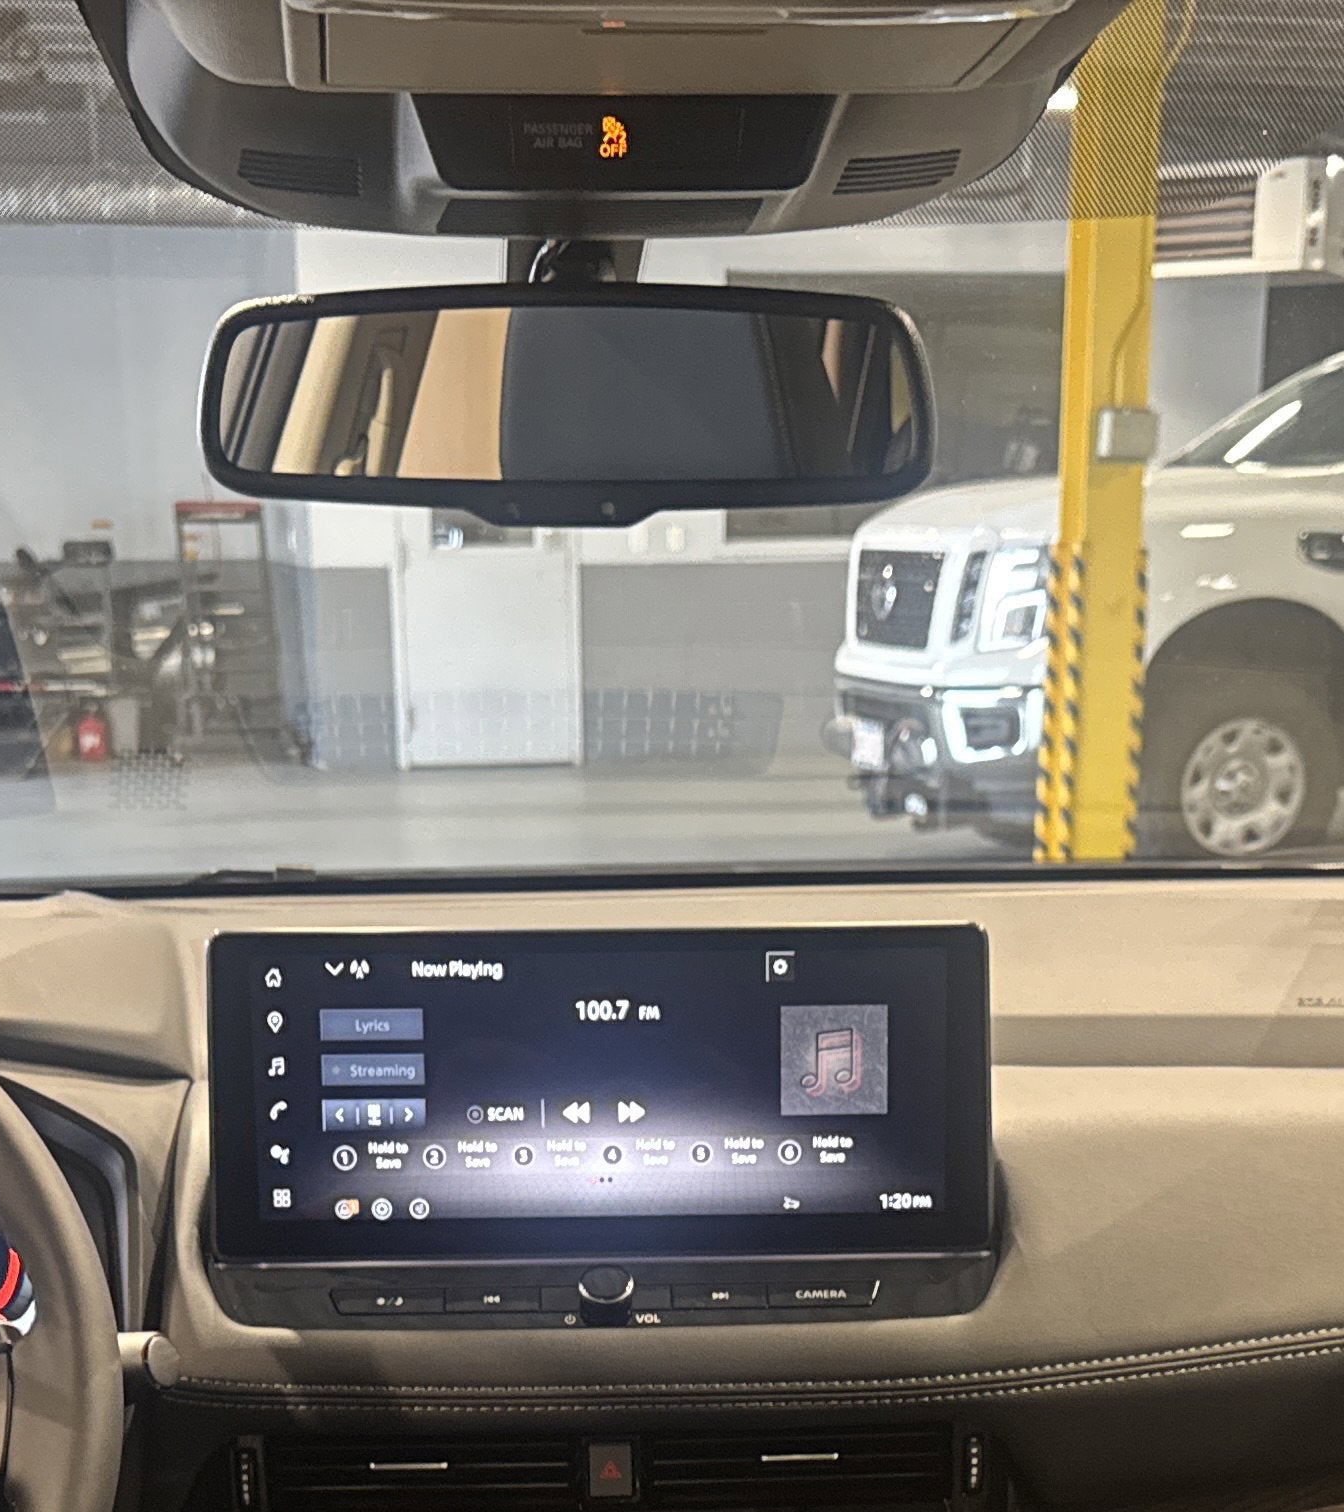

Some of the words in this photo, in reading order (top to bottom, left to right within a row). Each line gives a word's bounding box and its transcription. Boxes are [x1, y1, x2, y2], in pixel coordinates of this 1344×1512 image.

[523, 122, 593, 137] PASSENGER
[533, 137, 555, 149] AIR
[558, 137, 583, 149] BAG
[599, 143, 628, 158] OFF
[411, 960, 447, 978] Now
[448, 959, 504, 981] Playing
[575, 999, 630, 1022] 100.7
[638, 1004, 661, 1021] FM
[355, 1018, 391, 1035] Lyrics
[350, 1064, 416, 1081] Streaming
[487, 1106, 525, 1122] SCAN
[368, 1141, 393, 1155] Hold
[395, 1142, 409, 1155] to
[457, 1140, 482, 1154] Hold
[484, 1141, 498, 1154] to
[546, 1139, 571, 1152] Hold
[573, 1140, 587, 1152] to
[635, 1138, 660, 1151] Hold
[662, 1139, 676, 1151] to
[724, 1137, 749, 1150] Hold
[751, 1138, 765, 1150] to
[812, 1136, 837, 1149] Hold
[839, 1137, 854, 1149] to
[375, 1157, 403, 1170] Save
[465, 1156, 491, 1169] Save
[554, 1154, 580, 1167] Save
[643, 1153, 669, 1167] Save
[731, 1152, 758, 1165] Save
[819, 1151, 846, 1164] Save
[879, 1192, 912, 1210] 1:20
[912, 1194, 933, 1209] PM
[794, 1288, 848, 1300] CAMERA
[635, 1313, 661, 1324] VOL
